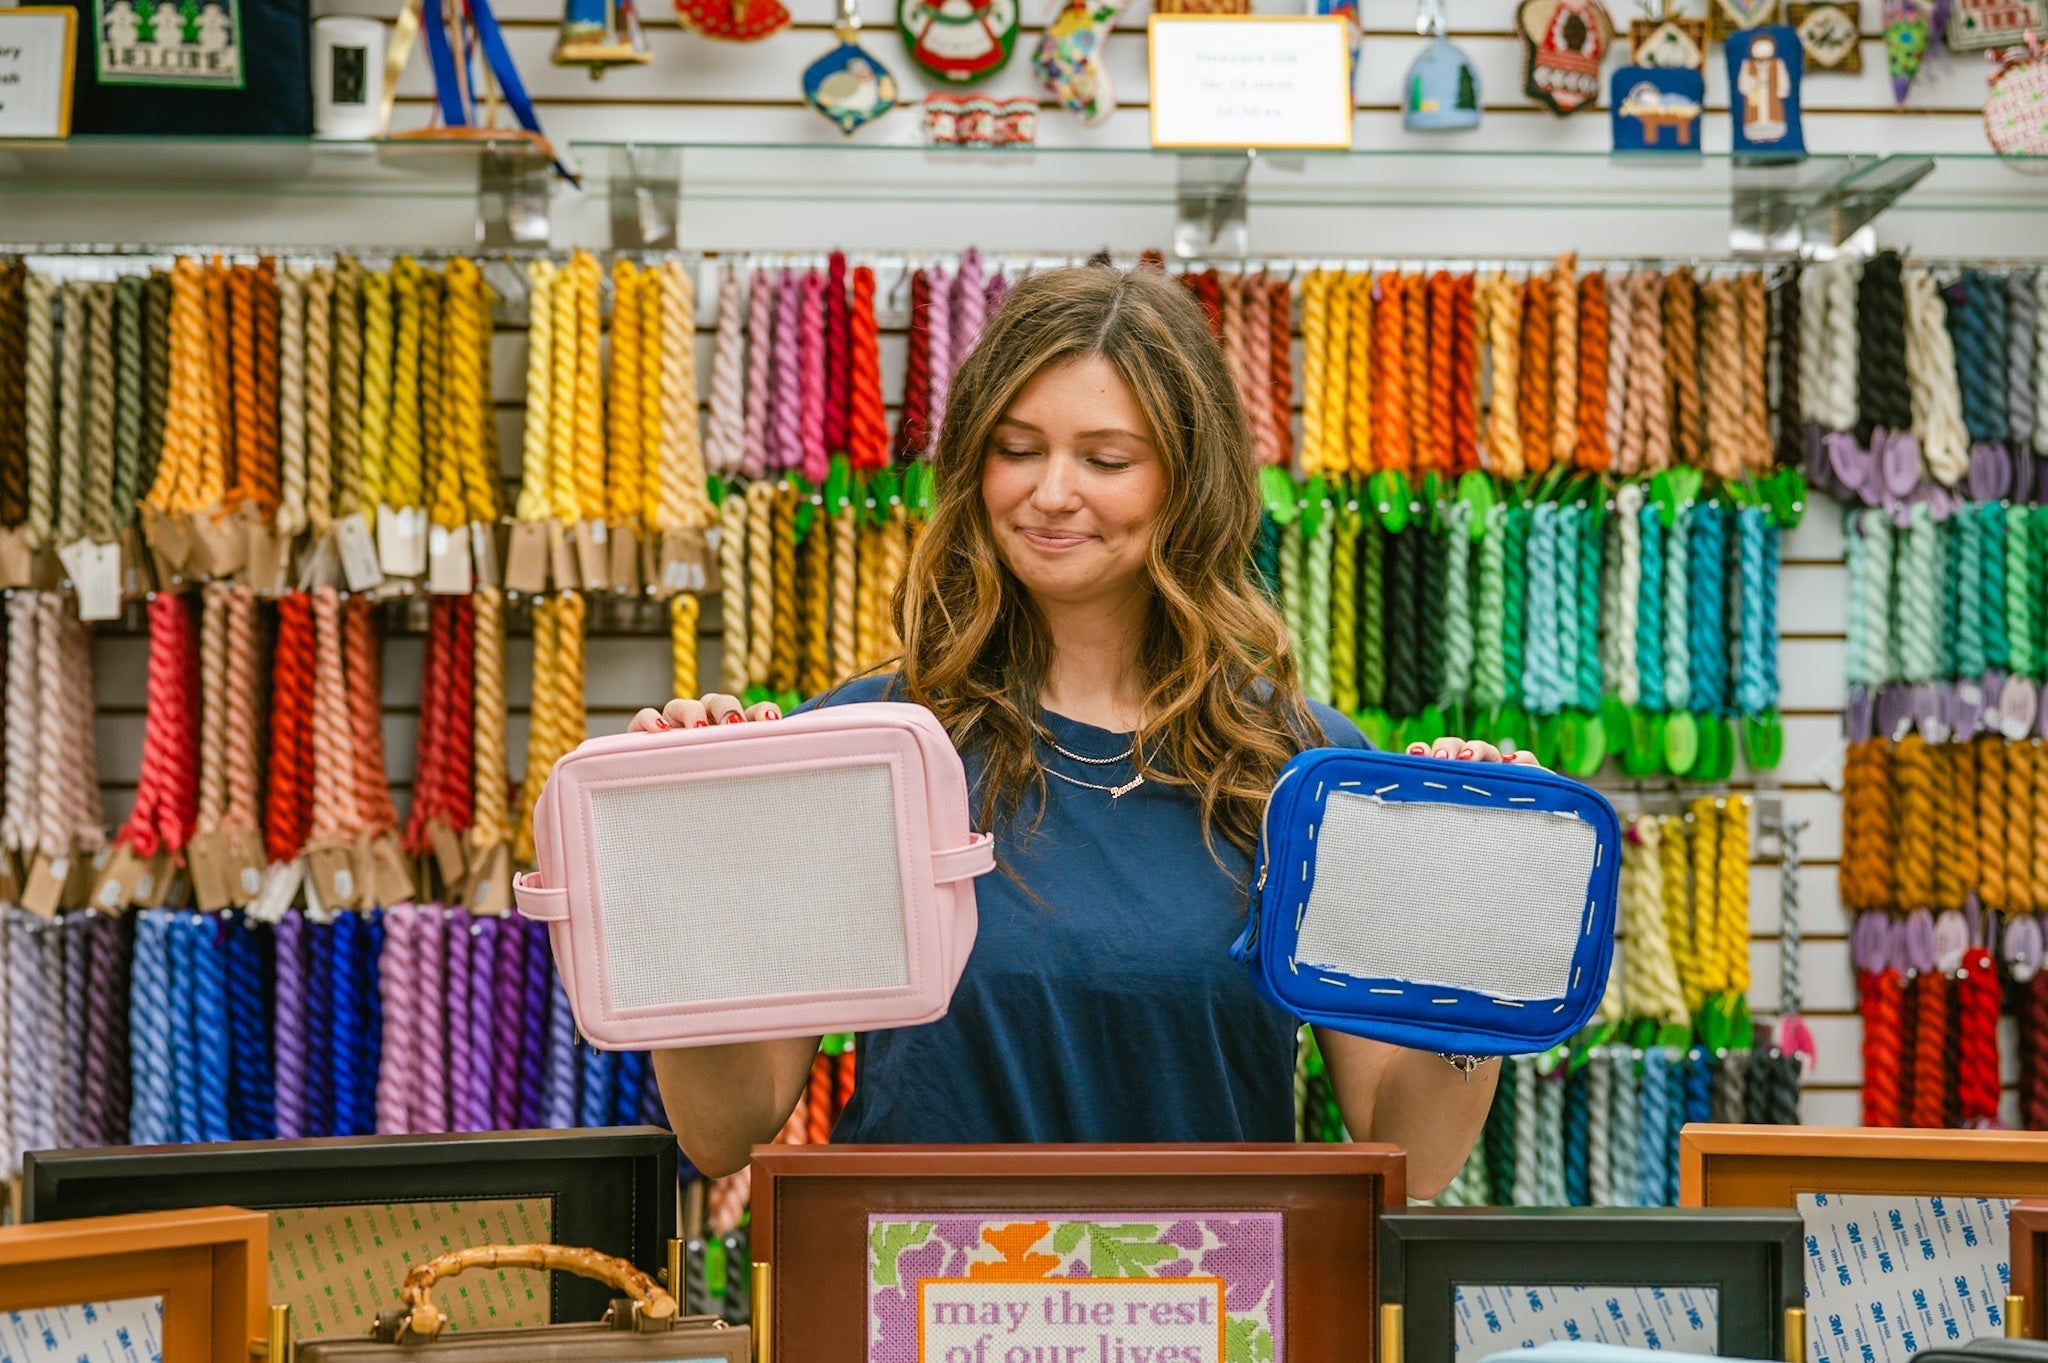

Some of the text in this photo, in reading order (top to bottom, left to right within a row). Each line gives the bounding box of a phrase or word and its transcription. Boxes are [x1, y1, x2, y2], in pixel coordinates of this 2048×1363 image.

[1930, 1196, 1946, 1218] 3M
[1888, 1209, 1904, 1231] 3M
[1846, 1222, 1862, 1244] 3M
[1962, 1225, 1978, 1247] 3M
[1804, 1235, 1821, 1257] 3M
[1919, 1238, 1935, 1260] 3M
[1878, 1251, 1893, 1273] 3M
[1836, 1265, 1852, 1286] 3M
[1996, 1263, 2013, 1284] 3M
[1954, 1276, 1970, 1297] 3M
[1526, 1291, 1543, 1311] 3M
[1606, 1299, 1623, 1321] 3M
[1912, 1289, 1928, 1310] 3M
[931, 1290, 1213, 1332] may the rest
[1484, 1311, 1502, 1333] 3M
[1686, 1308, 1703, 1330] 3M
[1870, 1302, 1886, 1323] 3M
[1986, 1305, 2002, 1327] 3M
[1564, 1319, 1581, 1341] 3M
[1829, 1314, 1844, 1336] 3M
[1944, 1318, 1960, 1340] 3M
[945, 1333, 1202, 1363] of our lives
[1644, 1329, 1661, 1350] 3M
[1902, 1331, 1917, 1353] 3M
[1860, 1344, 1876, 1363] 3M
